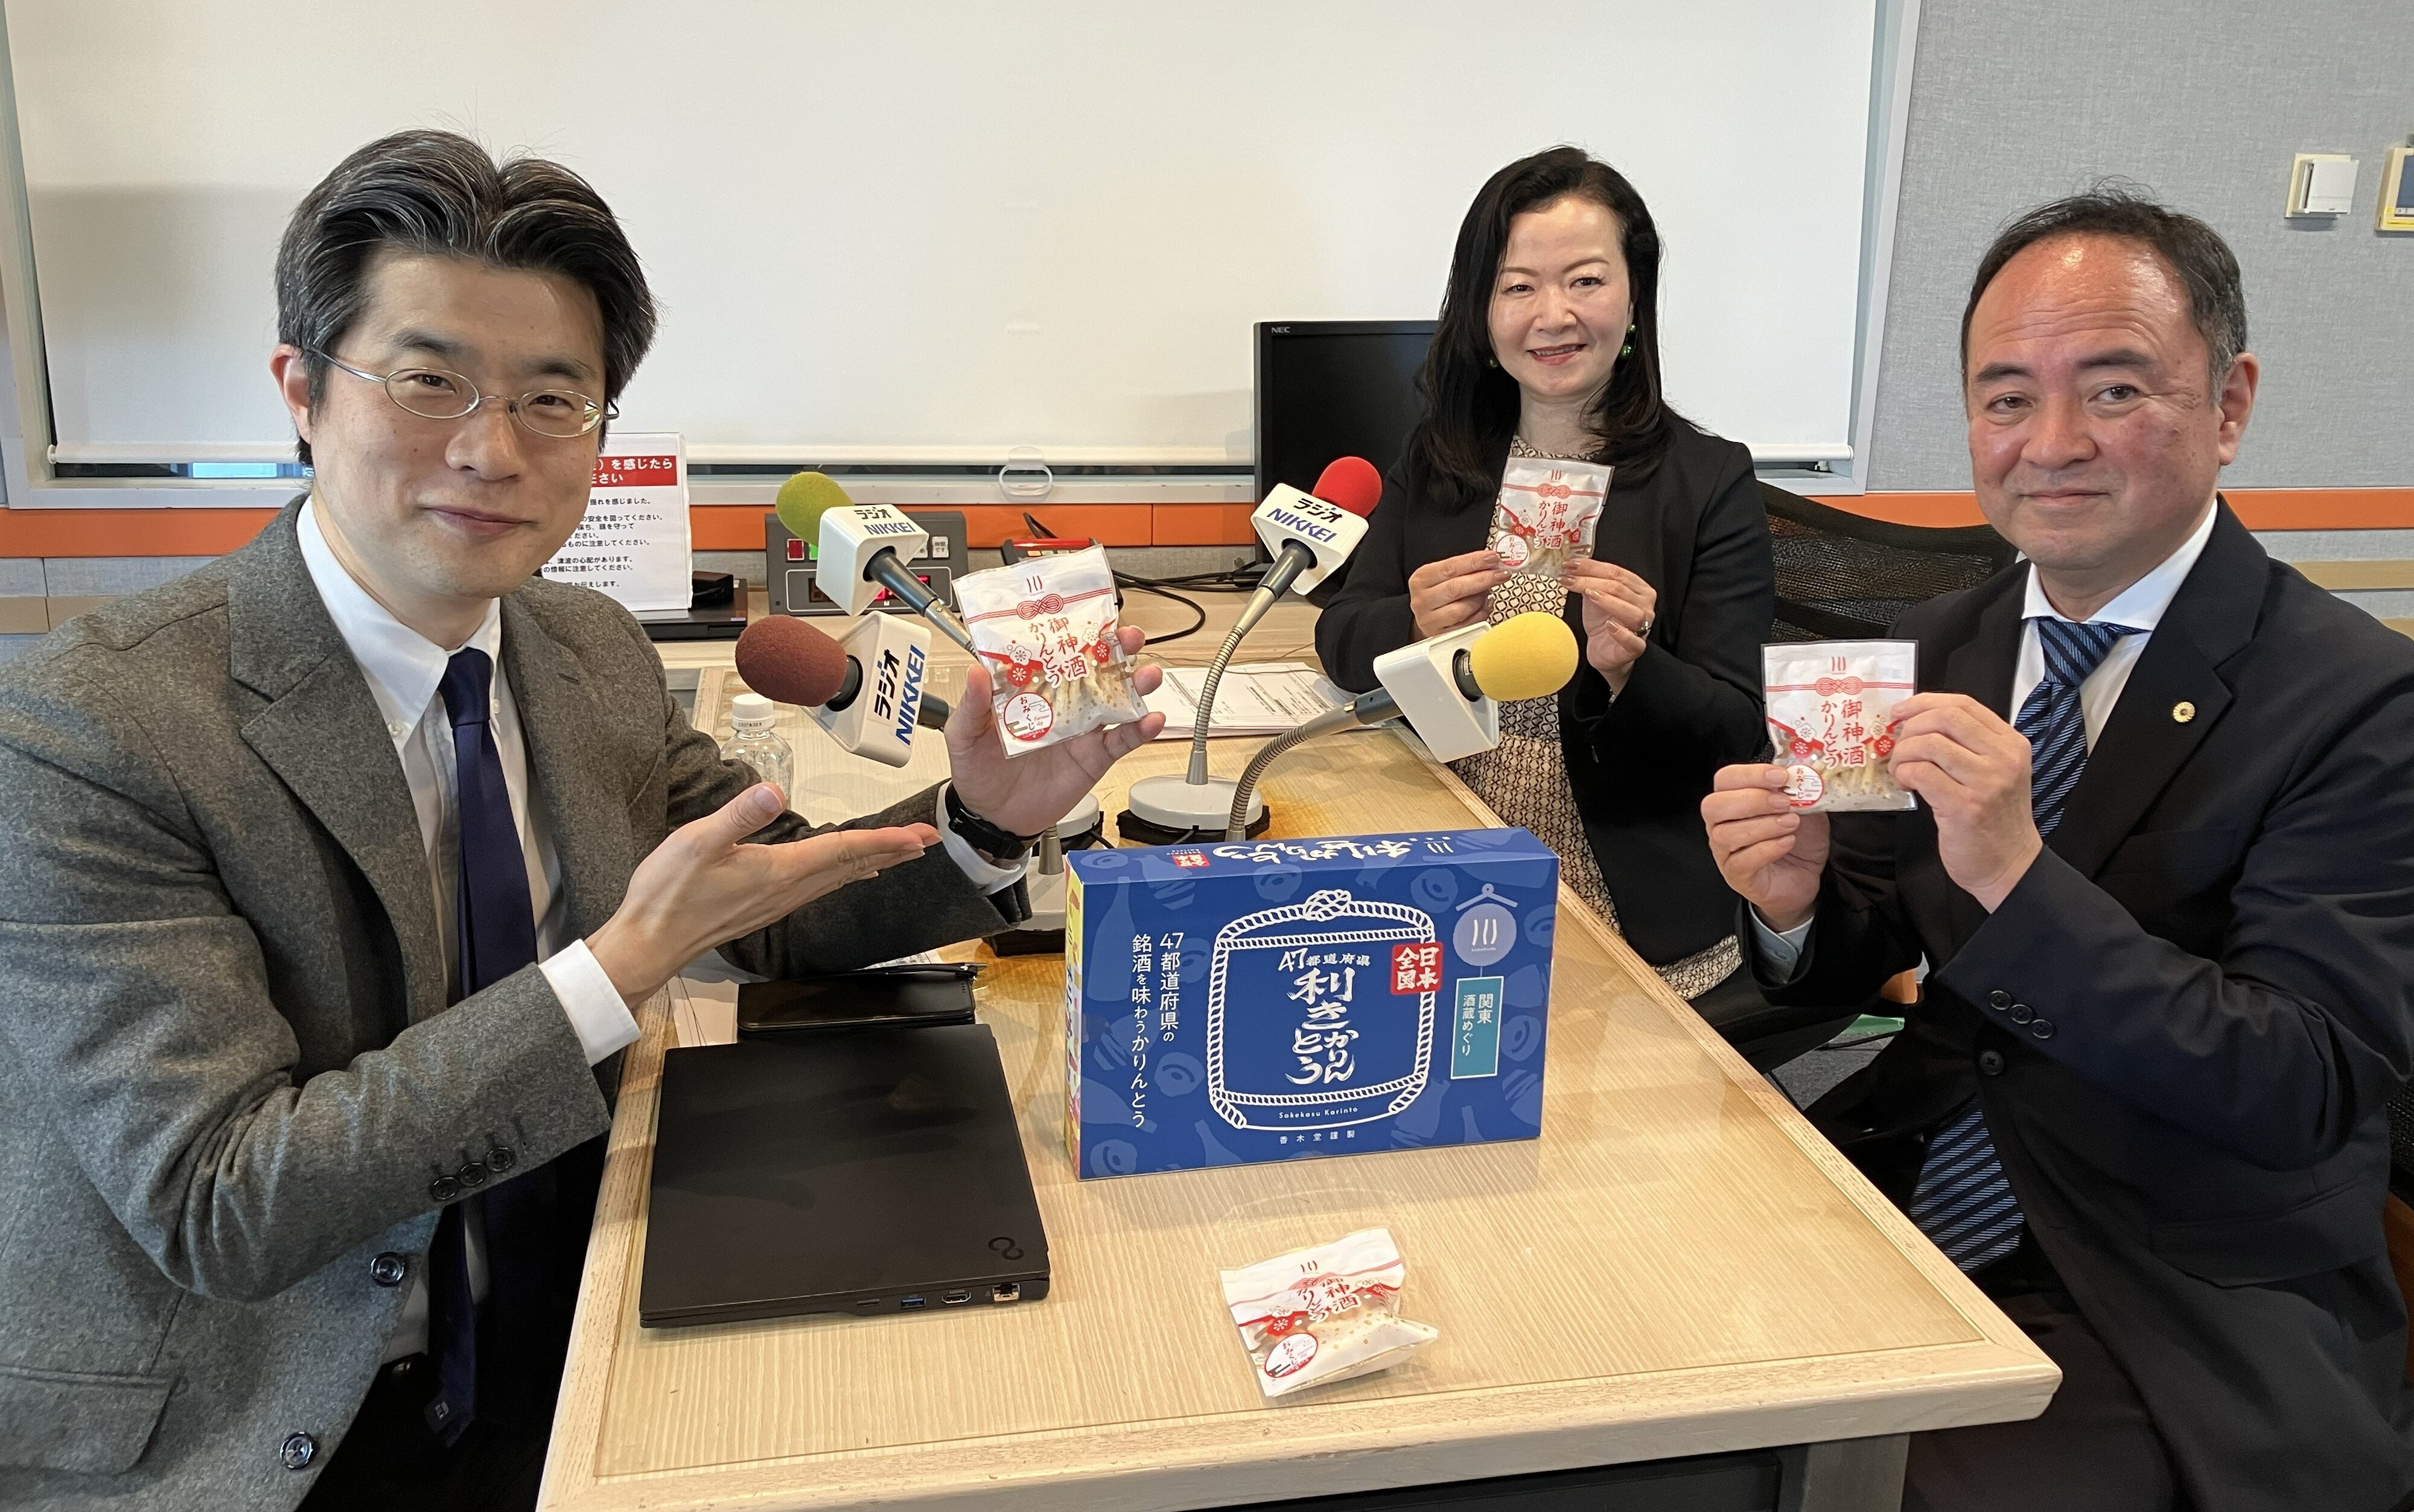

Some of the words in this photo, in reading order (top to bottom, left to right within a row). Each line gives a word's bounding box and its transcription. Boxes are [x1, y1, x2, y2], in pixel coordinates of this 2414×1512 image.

[853, 506, 893, 520] ラジオ
[863, 522, 916, 535] NIKKEI
[1266, 507, 1337, 543] NIKKEI
[1293, 498, 1343, 523] ラジオ
[1535, 500, 1550, 548] かりんとう
[1547, 501, 1568, 548] 御神酒
[1028, 621, 1060, 686] かりんとう
[1048, 616, 1088, 680] 御神酒
[874, 649, 900, 720] ラジオ
[895, 644, 925, 746] NIKKEI
[1019, 696, 1036, 731] おみくじ
[1820, 700, 1838, 767] かりんとう
[1841, 699, 1865, 766] 御神酒
[1796, 767, 1804, 799] おみくじ
[1278, 947, 1371, 972] 47都道府県
[1159, 932, 1185, 1043] 47都道府県の
[1477, 993, 1494, 1024] 関東
[1130, 933, 1153, 1128] 銘酒を味わうかりんとう
[1462, 994, 1476, 1056] 酒蔵めぐり
[1324, 1107, 1358, 1116] Karinto
